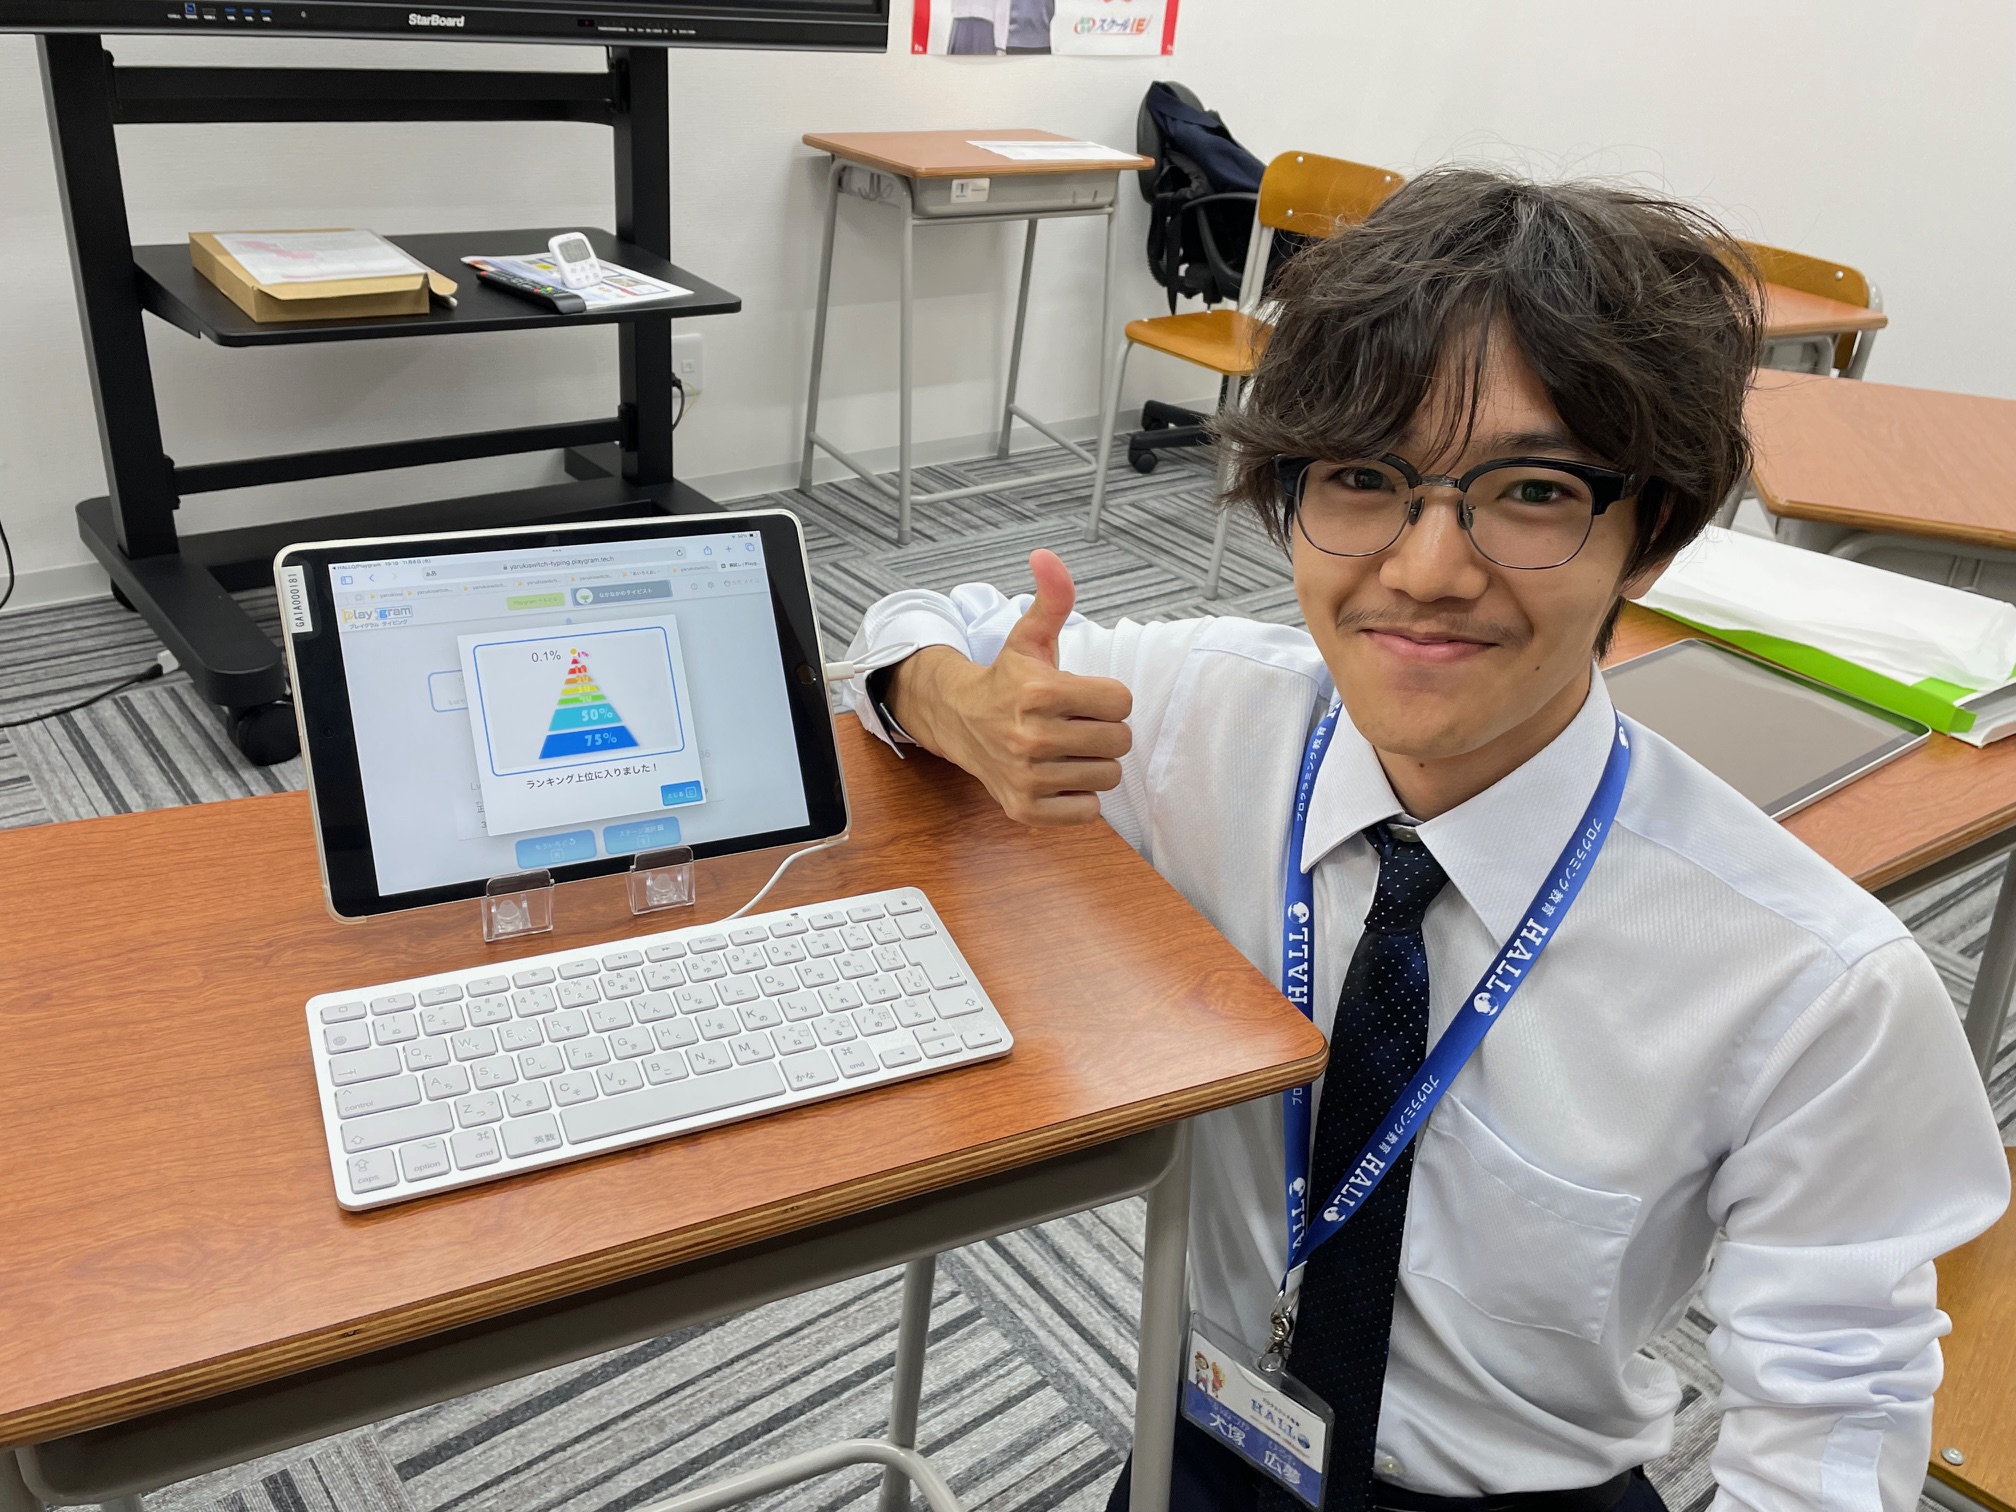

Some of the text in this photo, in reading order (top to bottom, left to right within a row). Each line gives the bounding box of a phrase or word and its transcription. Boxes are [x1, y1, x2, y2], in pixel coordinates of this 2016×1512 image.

[408, 12, 466, 28] StarBoard
[509, 555, 615, 571] yarukiswitch-typing.playgram.tech
[599, 587, 653, 598] なかなかのタイピスト
[531, 650, 561, 663] 0.1%
[581, 707, 613, 722] 50%
[584, 732, 618, 747] 75%
[526, 763, 658, 790] ランキング上位に入りました！
[1296, 726, 1327, 822] プログラミング教育
[1541, 818, 1602, 917] プログラミング教育
[850, 1062, 864, 1070] cmd
[794, 1072, 816, 1082] かな
[344, 1100, 374, 1112] control
[1378, 1074, 1440, 1155] プログラミング教育
[532, 1134, 556, 1144] 英数
[474, 1150, 494, 1160] cmd
[414, 1160, 440, 1172] option
[358, 1174, 380, 1184] caps
